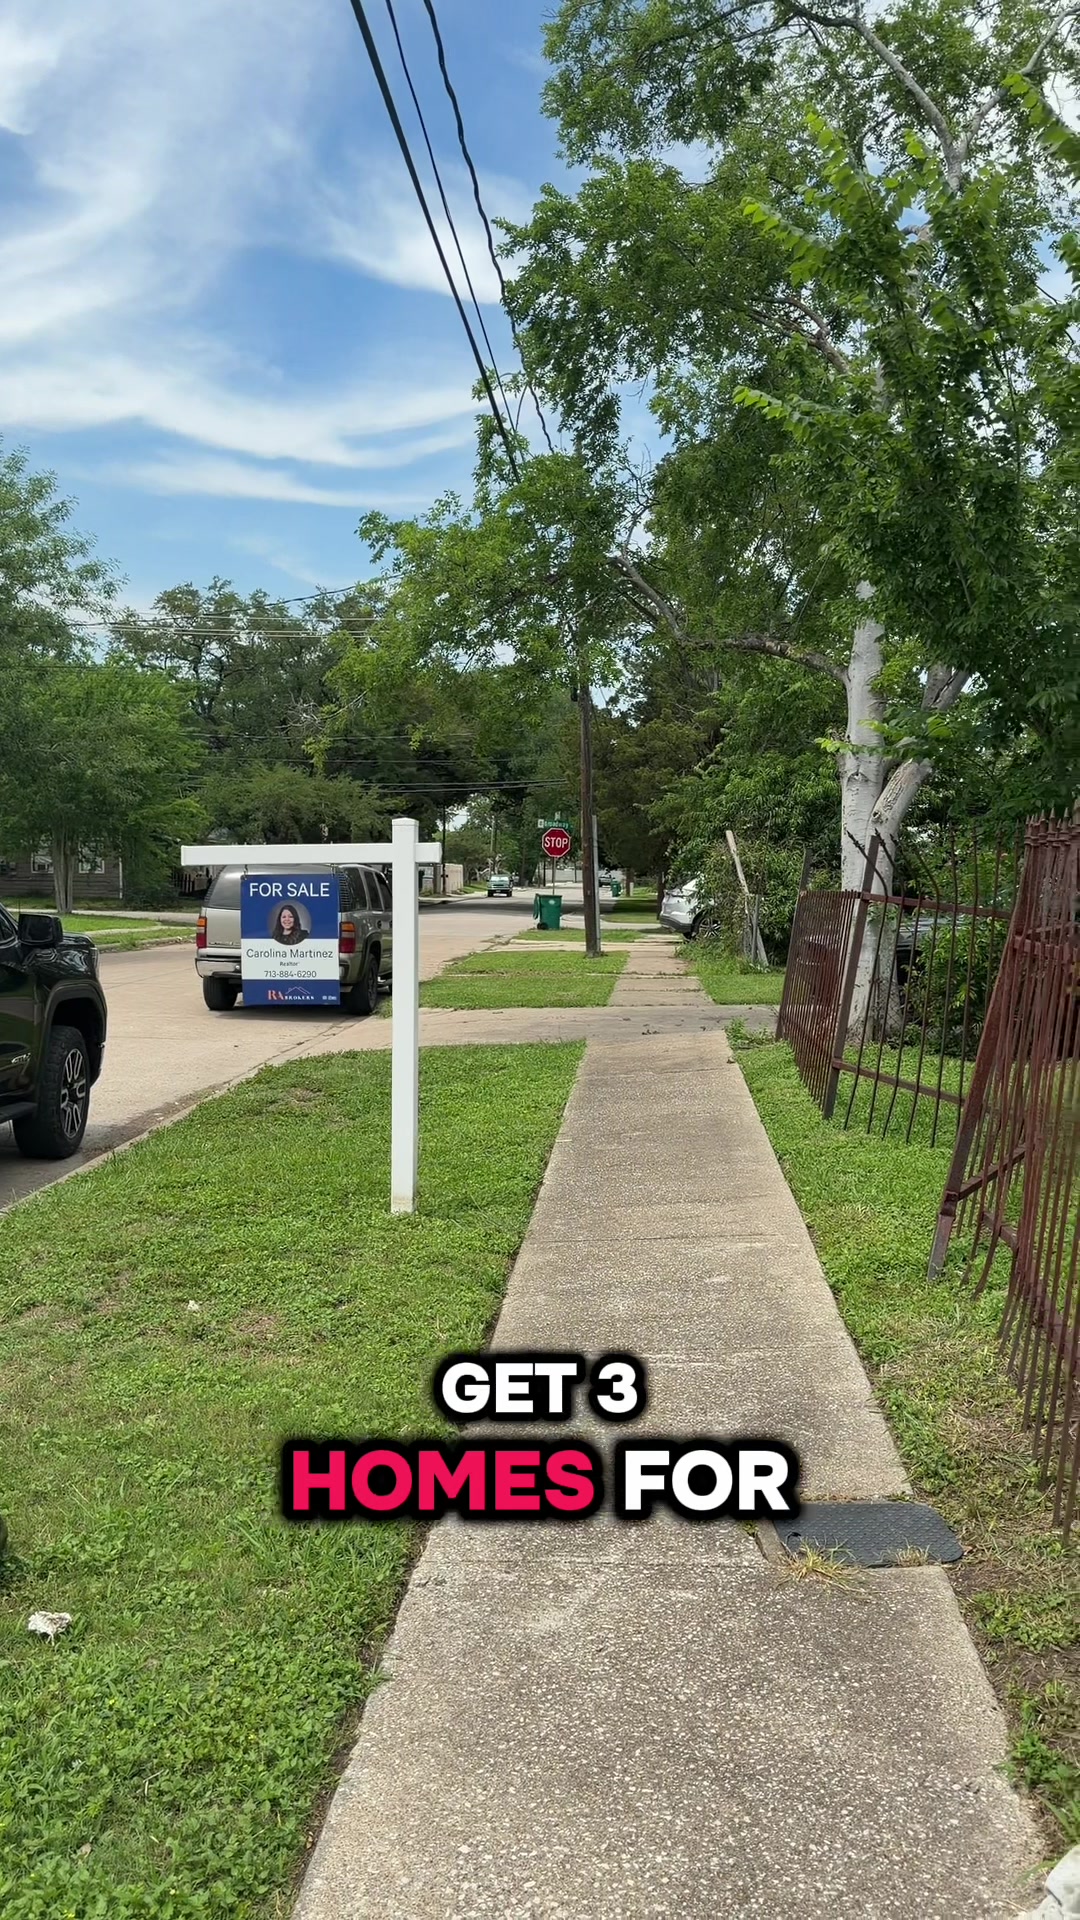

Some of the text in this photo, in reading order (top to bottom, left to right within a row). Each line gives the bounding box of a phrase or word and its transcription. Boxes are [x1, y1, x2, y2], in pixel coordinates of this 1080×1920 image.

[544, 837, 568, 848] STOP
[249, 882, 330, 897] FOR SALE
[246, 948, 333, 958] Carolina Martinez
[264, 970, 317, 978] 713-884-6290
[267, 989, 284, 1001] RA
